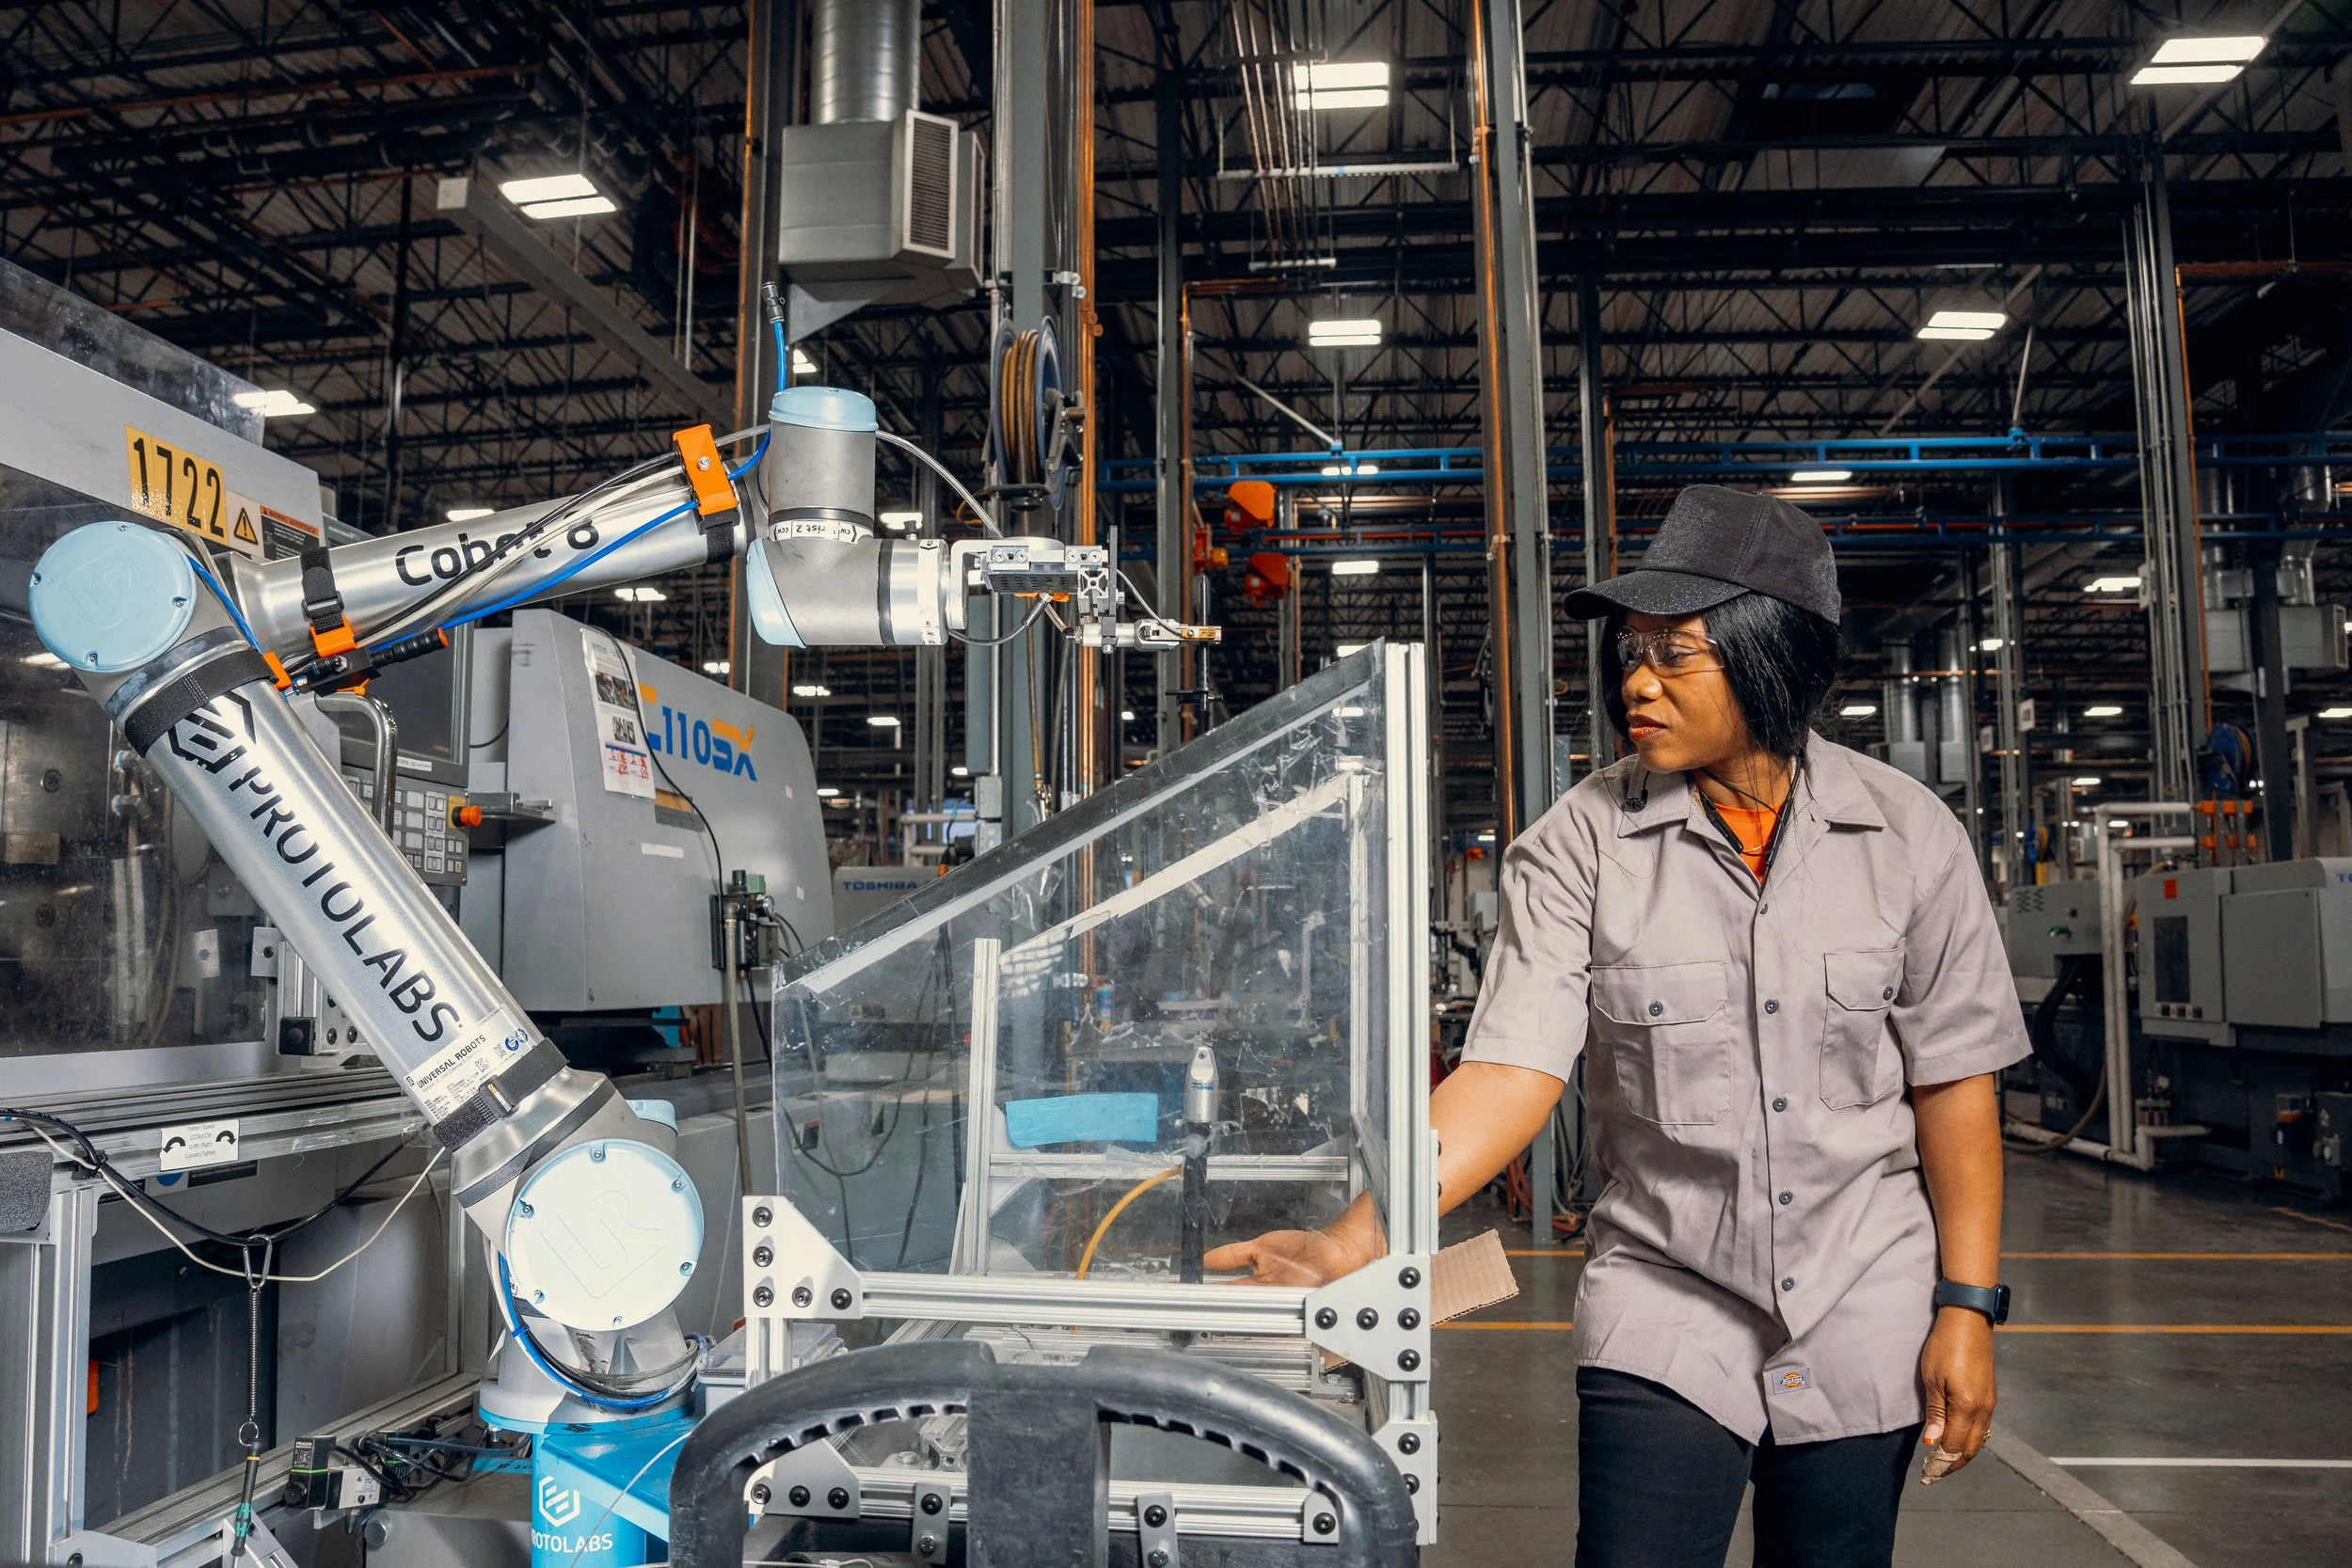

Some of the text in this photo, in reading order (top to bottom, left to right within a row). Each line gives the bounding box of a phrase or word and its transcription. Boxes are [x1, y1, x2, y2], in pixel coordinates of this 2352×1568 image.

[134, 437, 224, 538] 1722
[796, 524, 803, 533] 2
[228, 766, 461, 1042] PROTOLABS
[842, 880, 918, 891] TOSHIBA
[417, 1058, 455, 1088] UNIVERSAL
[453, 1035, 486, 1061] ROBOTS
[532, 1528, 613, 1554] ROTOLABS
